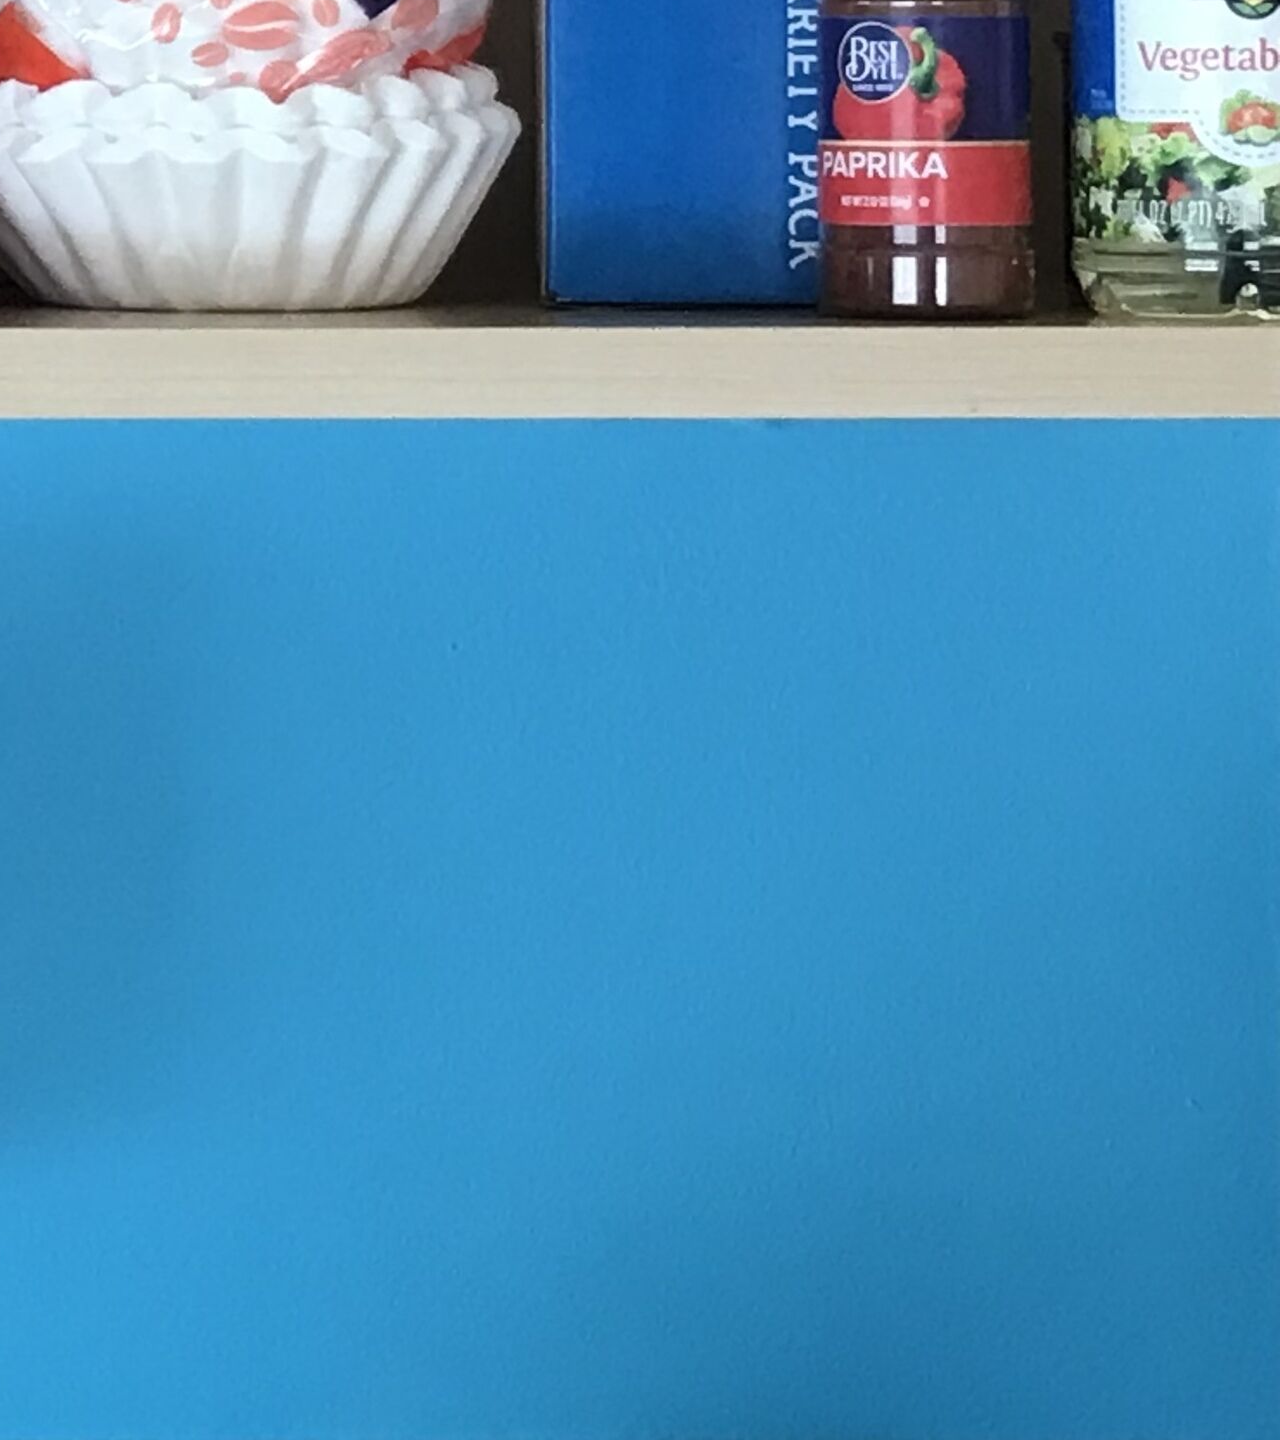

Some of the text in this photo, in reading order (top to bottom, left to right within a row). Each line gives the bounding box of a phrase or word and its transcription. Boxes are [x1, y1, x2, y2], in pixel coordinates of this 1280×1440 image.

[845, 35, 899, 82] BEST
[822, 151, 949, 179] PAPRIKA
[788, 152, 820, 270] PACK
